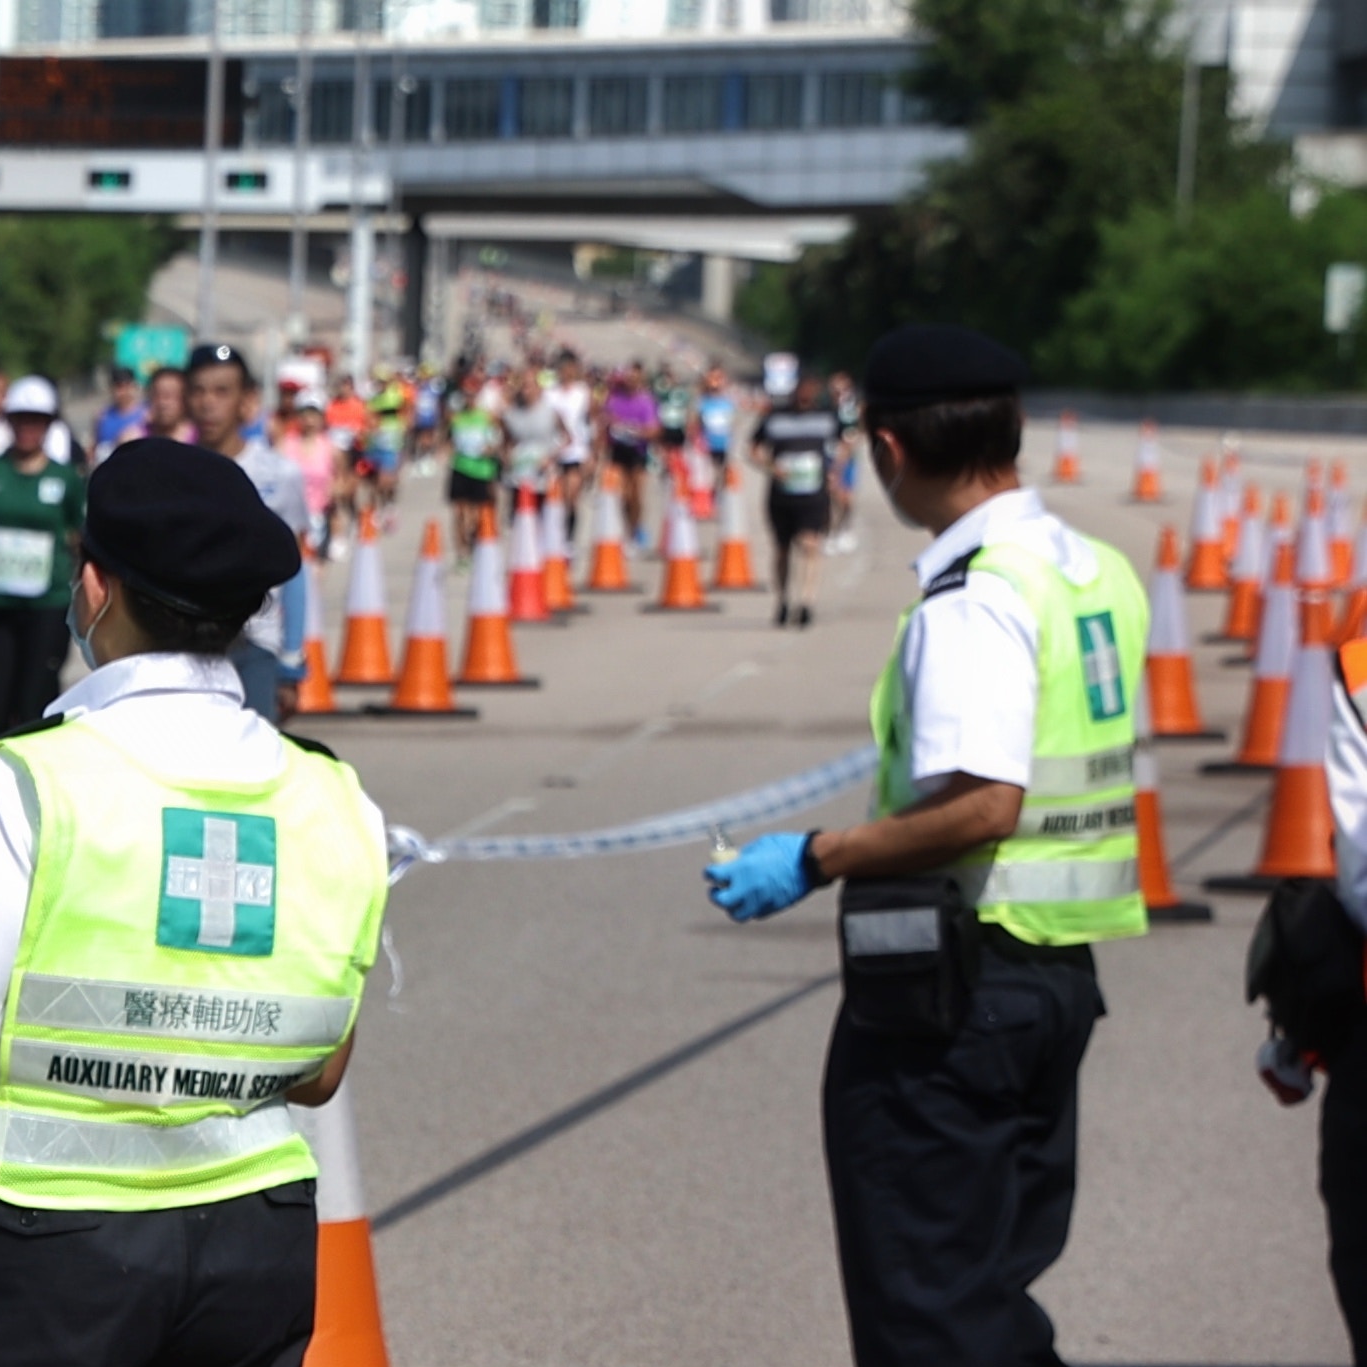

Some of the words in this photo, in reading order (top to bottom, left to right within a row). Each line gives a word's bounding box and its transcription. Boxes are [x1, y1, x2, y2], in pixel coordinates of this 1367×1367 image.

[124, 990, 282, 1036] 醫療輔助隊
[47, 1055, 169, 1094] AUXILIARY
[172, 1068, 246, 1099] MEDICAL
